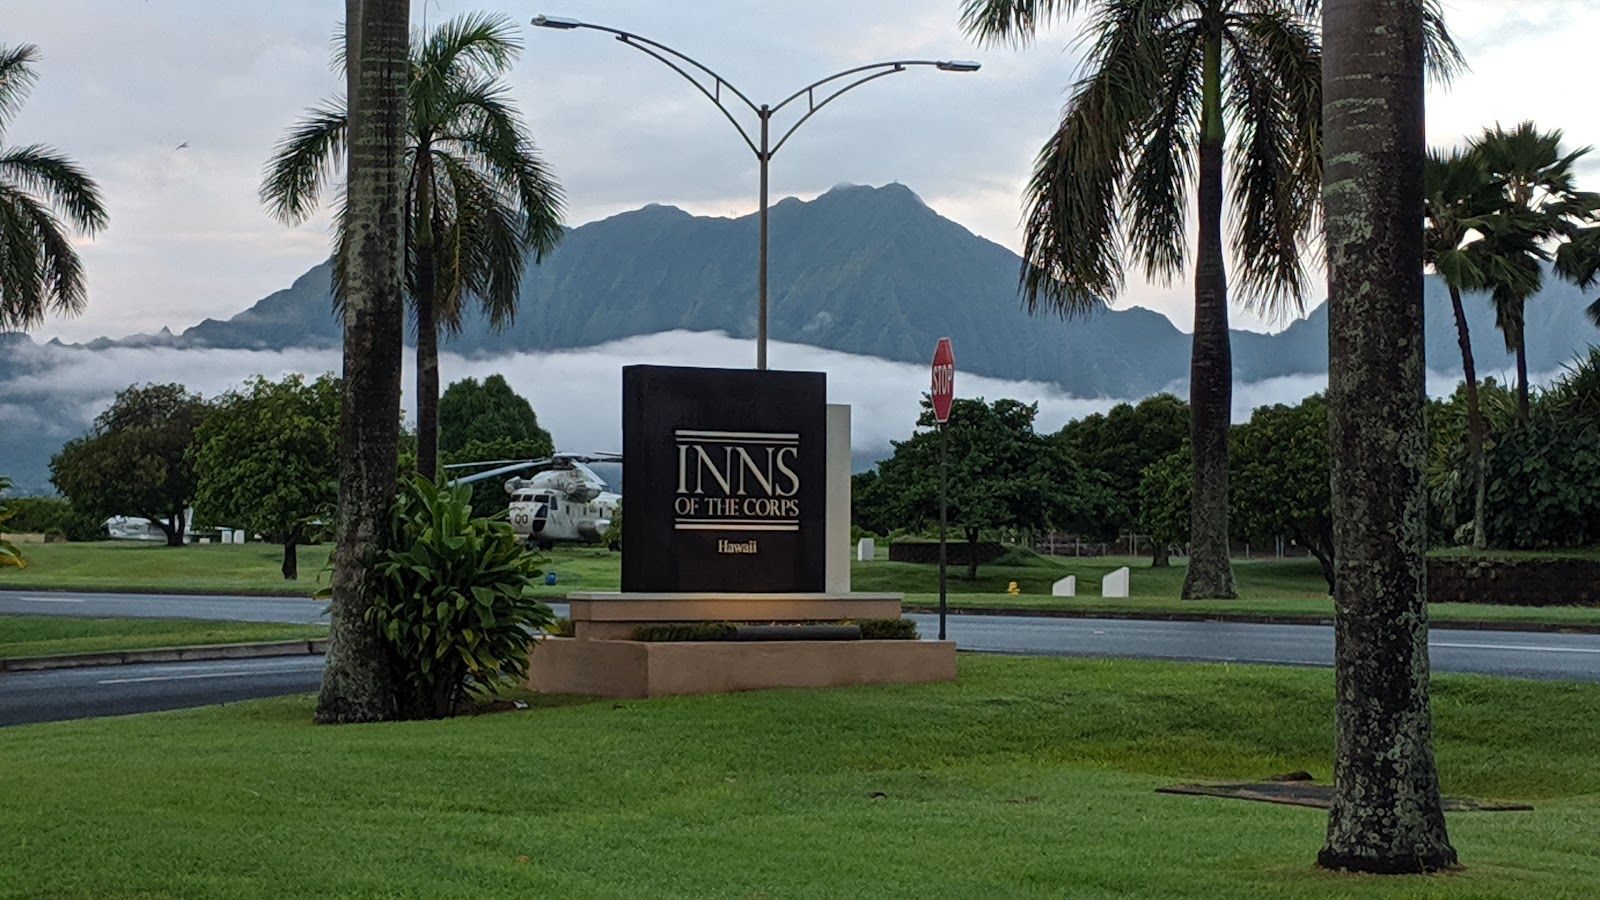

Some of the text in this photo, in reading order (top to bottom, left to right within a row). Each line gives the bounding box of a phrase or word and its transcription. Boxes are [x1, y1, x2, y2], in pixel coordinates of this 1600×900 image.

[933, 364, 953, 395] STOP
[676, 444, 799, 497] INNS
[675, 497, 799, 517] OF THE CORPS
[718, 540, 757, 554] Hawaii
